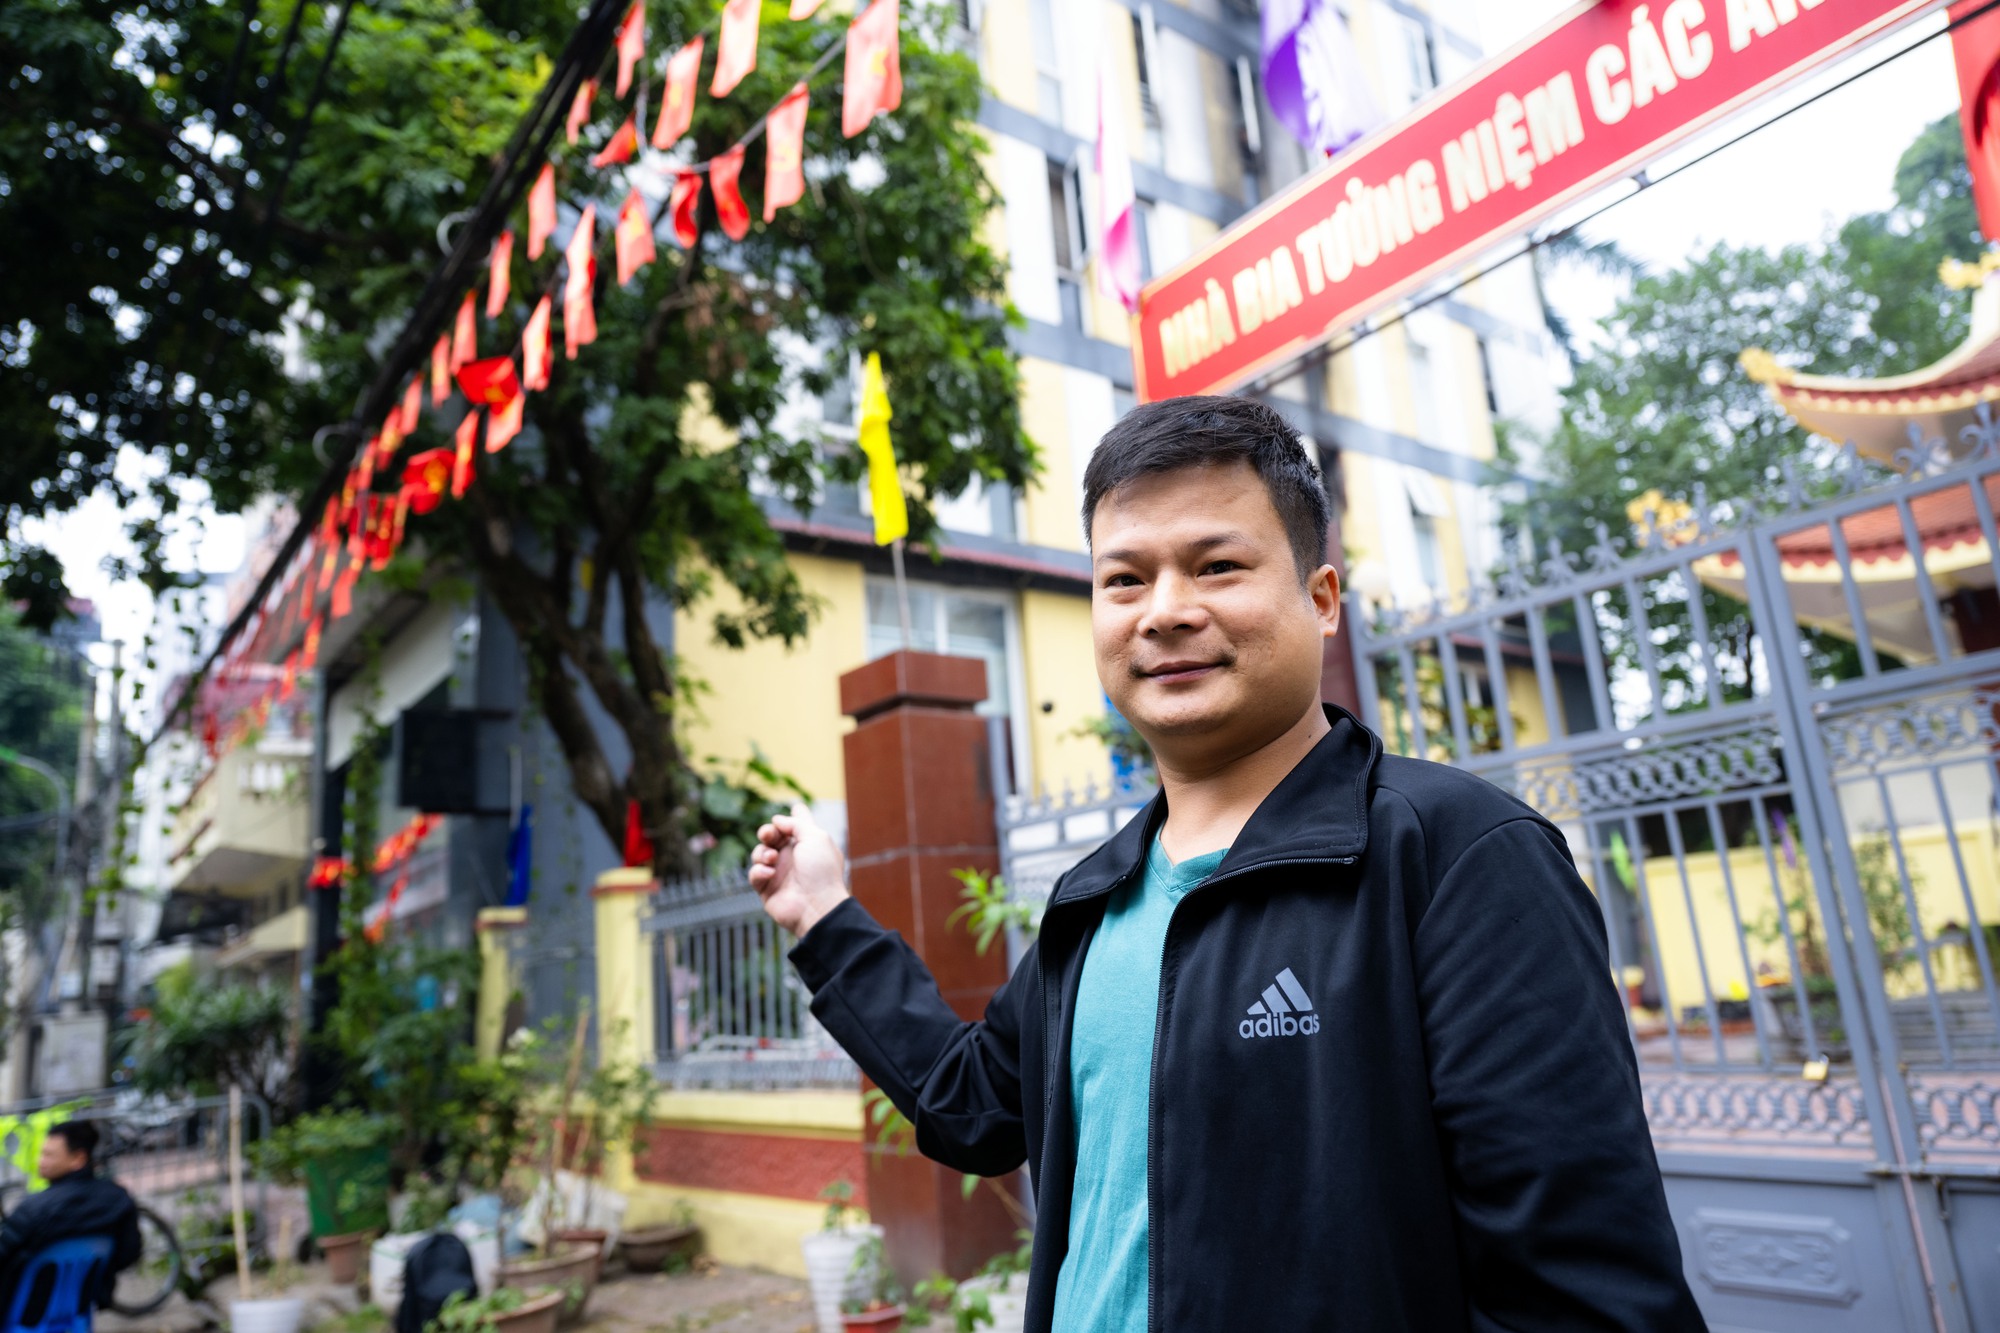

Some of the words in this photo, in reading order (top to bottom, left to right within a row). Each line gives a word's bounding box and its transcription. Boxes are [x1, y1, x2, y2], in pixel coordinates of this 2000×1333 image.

[1159, 277, 1236, 378] NHÀ
[1232, 245, 1303, 335] BIA
[1296, 160, 1444, 295] TƯỞNG
[1441, 70, 1585, 213] NIỆM
[1585, 0, 1714, 125] CÁC
